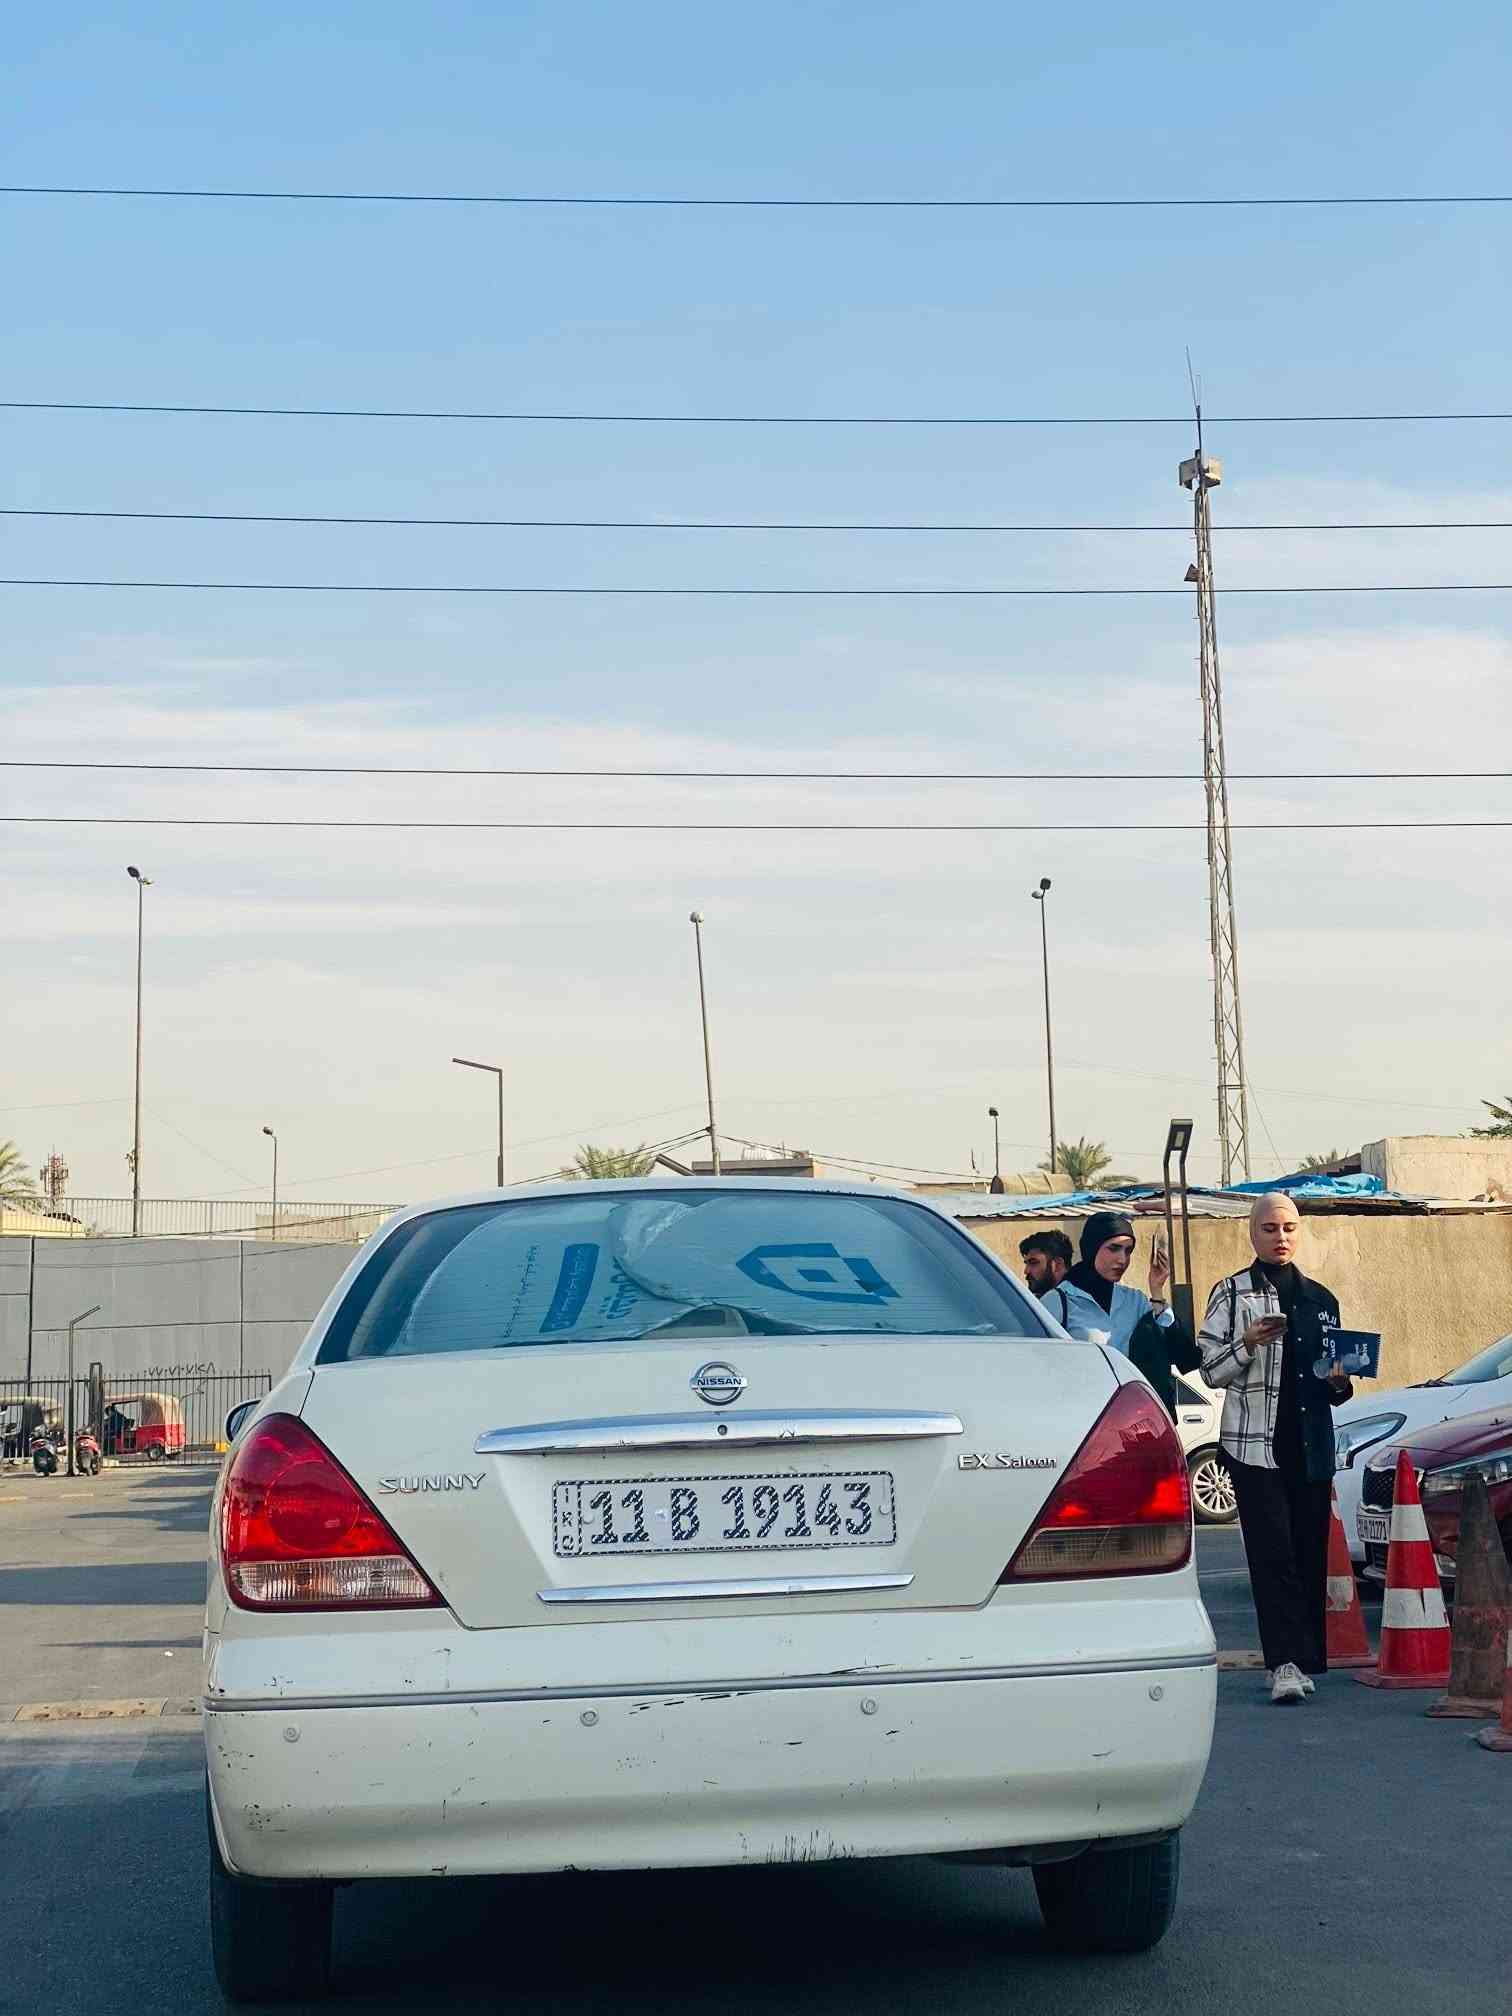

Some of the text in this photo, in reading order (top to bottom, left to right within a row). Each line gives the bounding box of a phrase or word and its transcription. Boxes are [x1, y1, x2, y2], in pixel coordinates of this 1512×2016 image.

[697, 1377, 742, 1386] NISSAN
[959, 1453, 1057, 1469] EX Saloon
[378, 1472, 488, 1494] SUNNY
[590, 1482, 873, 1544] 11 B 19143
